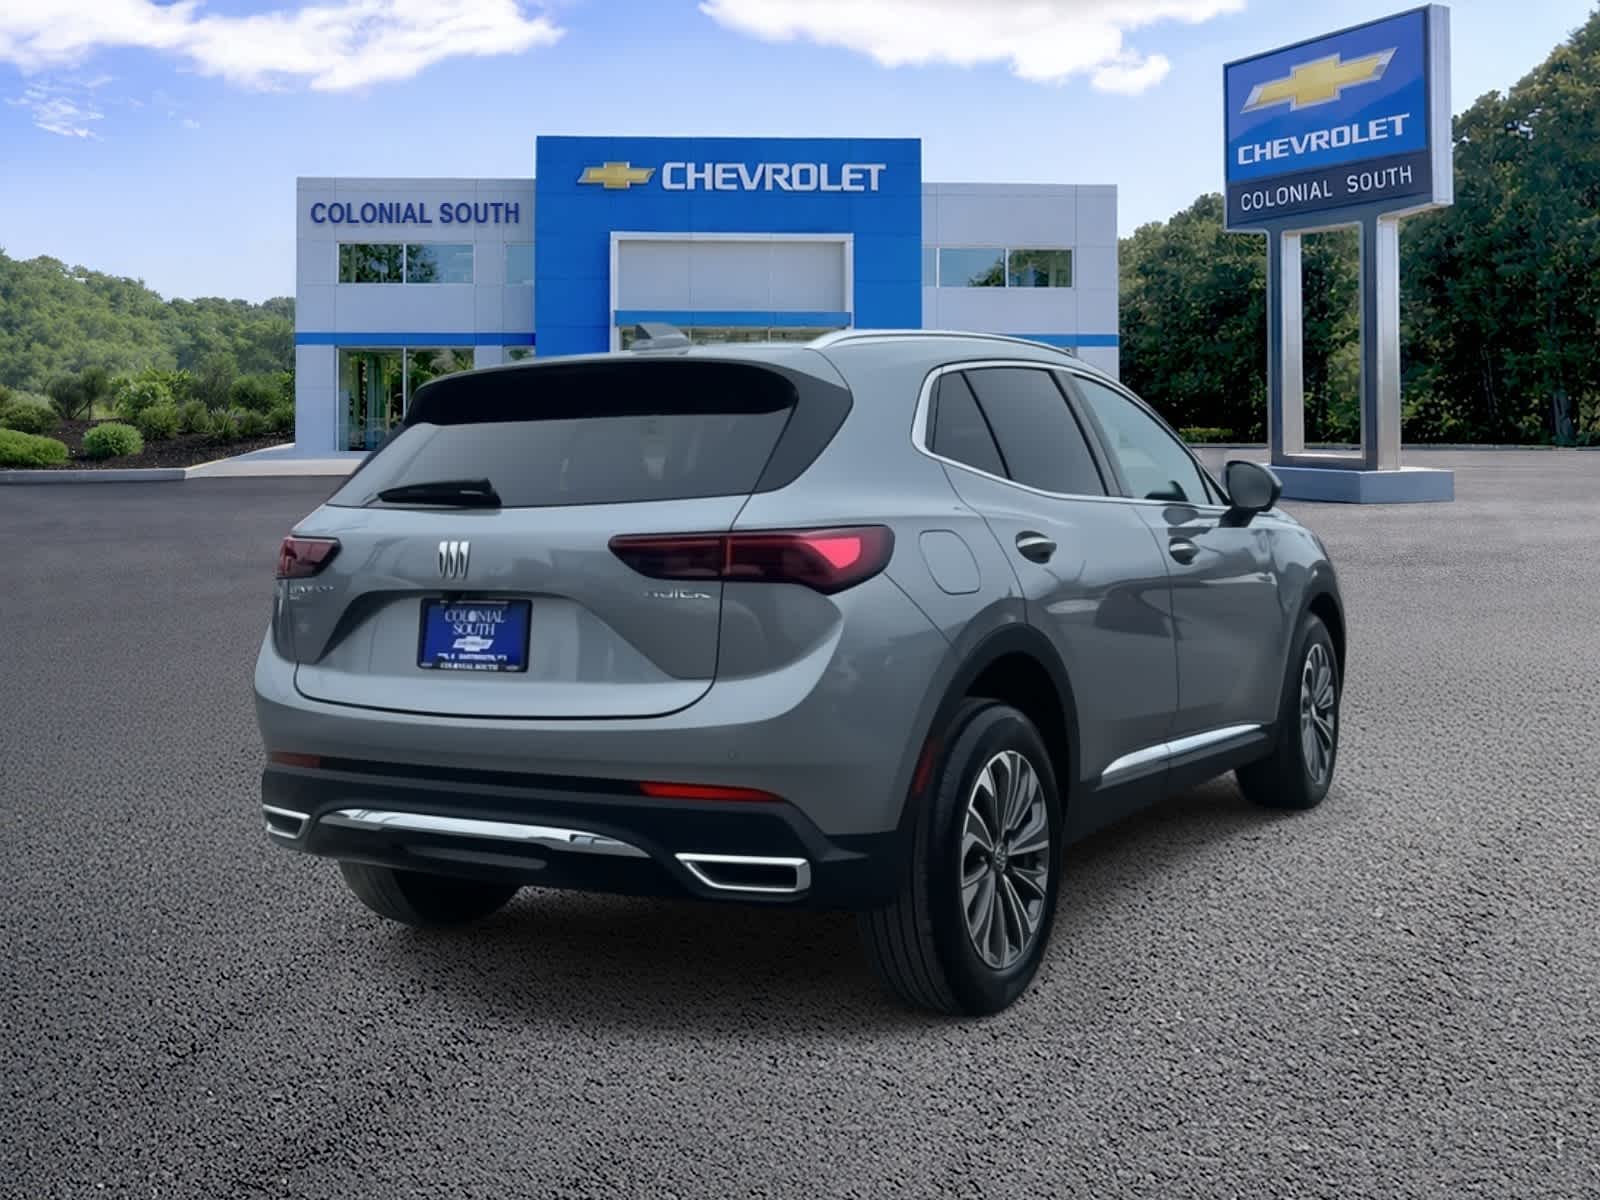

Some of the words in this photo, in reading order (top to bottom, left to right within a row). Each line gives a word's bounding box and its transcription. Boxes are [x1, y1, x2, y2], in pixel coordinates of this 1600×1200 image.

[1238, 113, 1410, 165] CHEVROLET
[662, 162, 887, 191] CHEVROLET
[1240, 180, 1333, 211] COLONIAL
[1346, 165, 1412, 193] SOUTH
[310, 202, 432, 224] COLONIAL
[439, 202, 520, 224] SOUTH
[445, 609, 505, 623] COLONIAL
[452, 623, 496, 635] SOUTH
